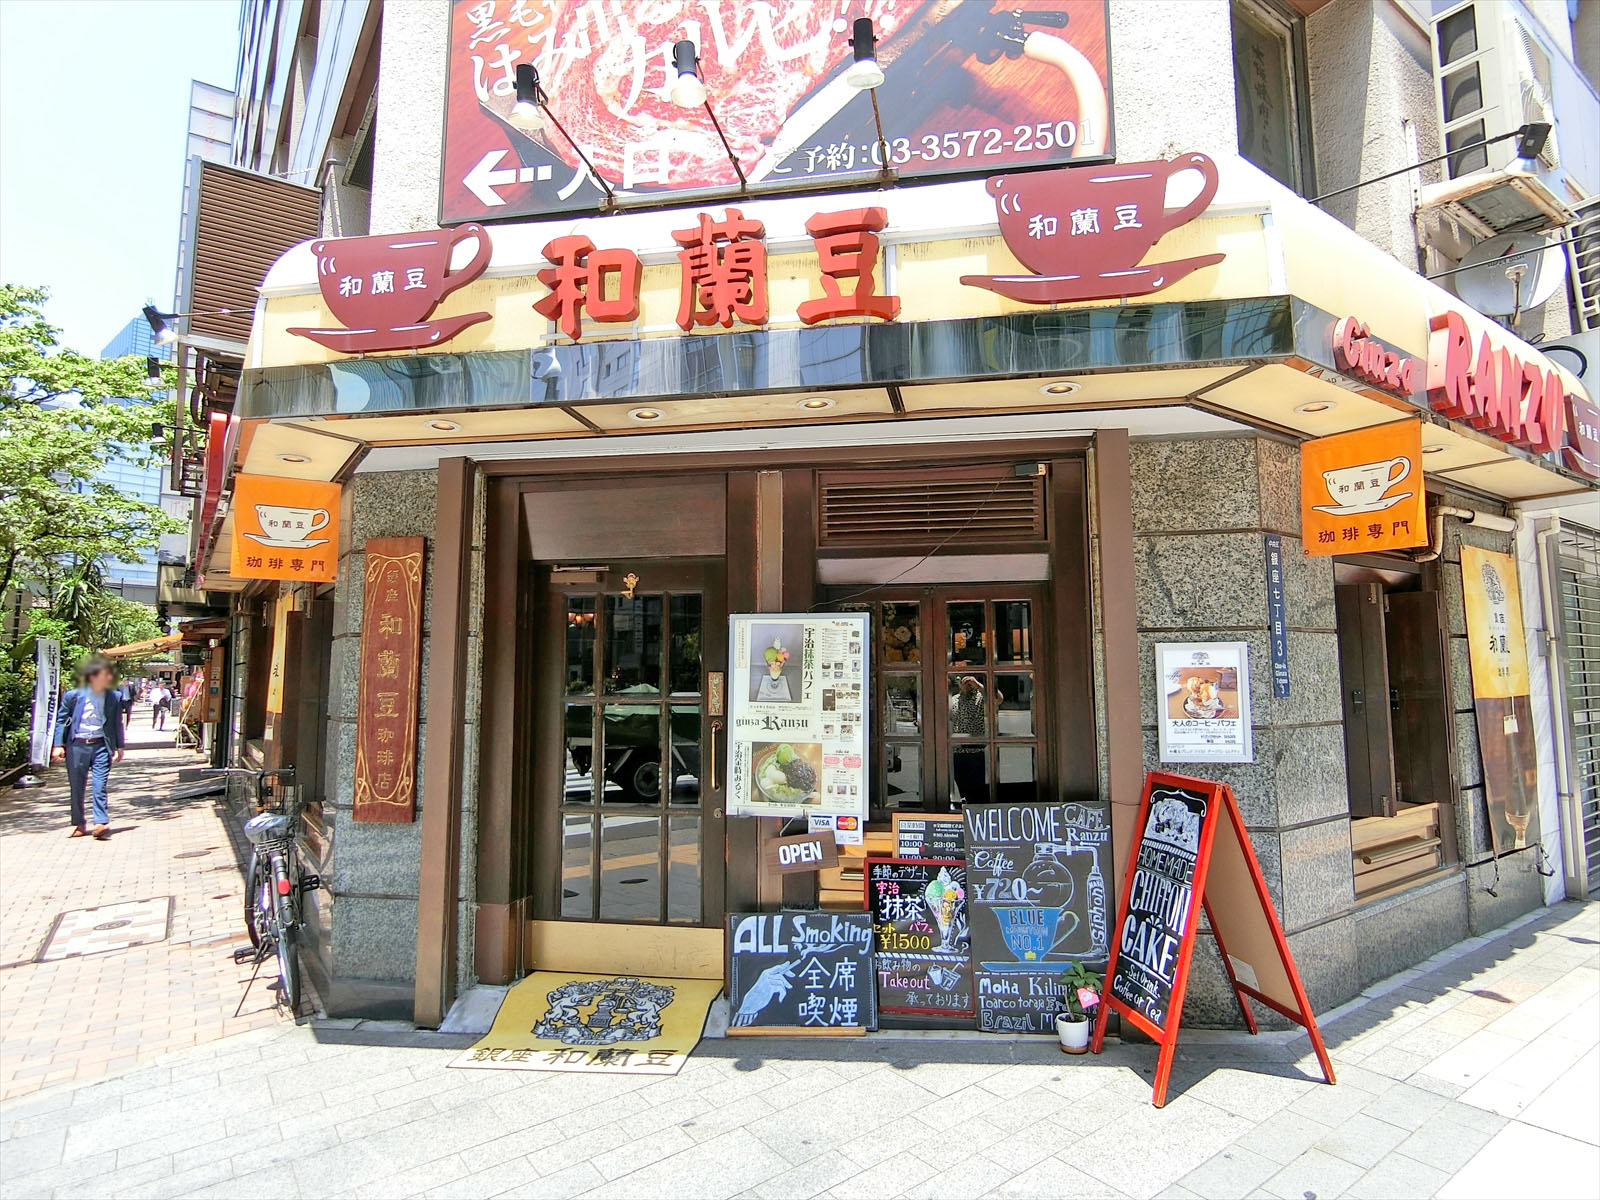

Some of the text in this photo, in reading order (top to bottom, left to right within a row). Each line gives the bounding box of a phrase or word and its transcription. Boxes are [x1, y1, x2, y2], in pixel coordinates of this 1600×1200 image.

[557, 139, 671, 201] 入口
[1028, 204, 1143, 240] 和蘭豆
[339, 268, 428, 297] 和蘭豆
[532, 208, 901, 340] 和蘭豆
[1334, 310, 1564, 453] Ginza RANZU
[1338, 478, 1380, 494] 和蘭豆
[268, 519, 305, 530] 和蘭豆
[1318, 520, 1410, 543] 珈琲専門
[246, 556, 325, 572] 珈琲専門
[804, 627, 815, 700] 宇治抹茶パフェ
[1172, 719, 1237, 728] 大人のコーヒーパフェ
[966, 807, 1062, 841] WELCOME
[1066, 827, 1109, 842] Ranzu
[778, 841, 823, 865] OPEN
[974, 850, 1014, 876] Coffee
[1137, 845, 1196, 884] HOMEMADE
[872, 864, 928, 879] 季節のデザート
[876, 881, 900, 895] 宇治
[881, 895, 926, 921] 抹茶
[1130, 871, 1193, 936] CHIFFON
[873, 923, 896, 933] セット
[909, 921, 934, 933] パフェ
[1008, 909, 1044, 926] BLUE
[734, 915, 788, 953] ALL
[880, 933, 930, 950] ¥1500
[1122, 914, 1178, 981] CAKE
[799, 957, 857, 991] 全席
[799, 993, 858, 1026] 喫煙
[905, 992, 969, 1009] 承っております
[1144, 995, 1162, 1025] Tea
[981, 1009, 1036, 1031] Brazil
